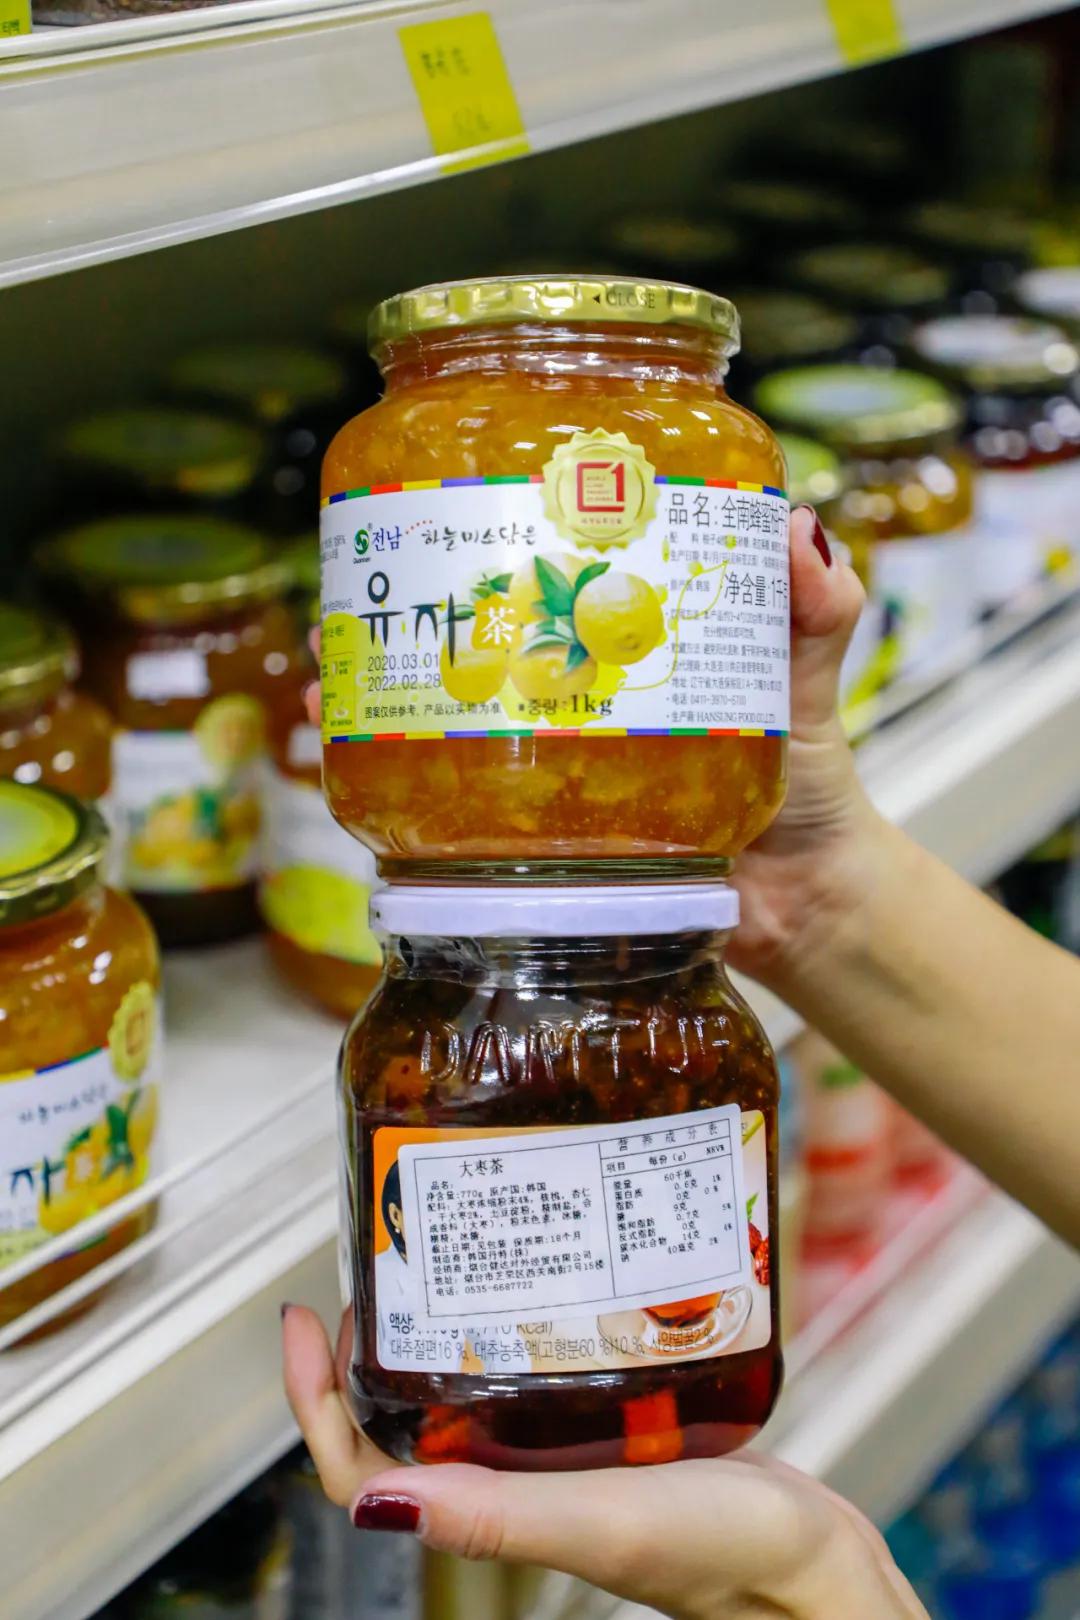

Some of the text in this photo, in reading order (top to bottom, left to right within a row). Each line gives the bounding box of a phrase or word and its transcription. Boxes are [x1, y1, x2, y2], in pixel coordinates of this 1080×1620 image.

[606, 291, 656, 310] CLOSE
[372, 525, 403, 552] 전남
[357, 570, 470, 669] 유자
[481, 606, 517, 647] 茶
[366, 652, 440, 672] 2020.03.01
[366, 673, 442, 693] 2022.02.28
[459, 1157, 504, 1178] 大枣茶
